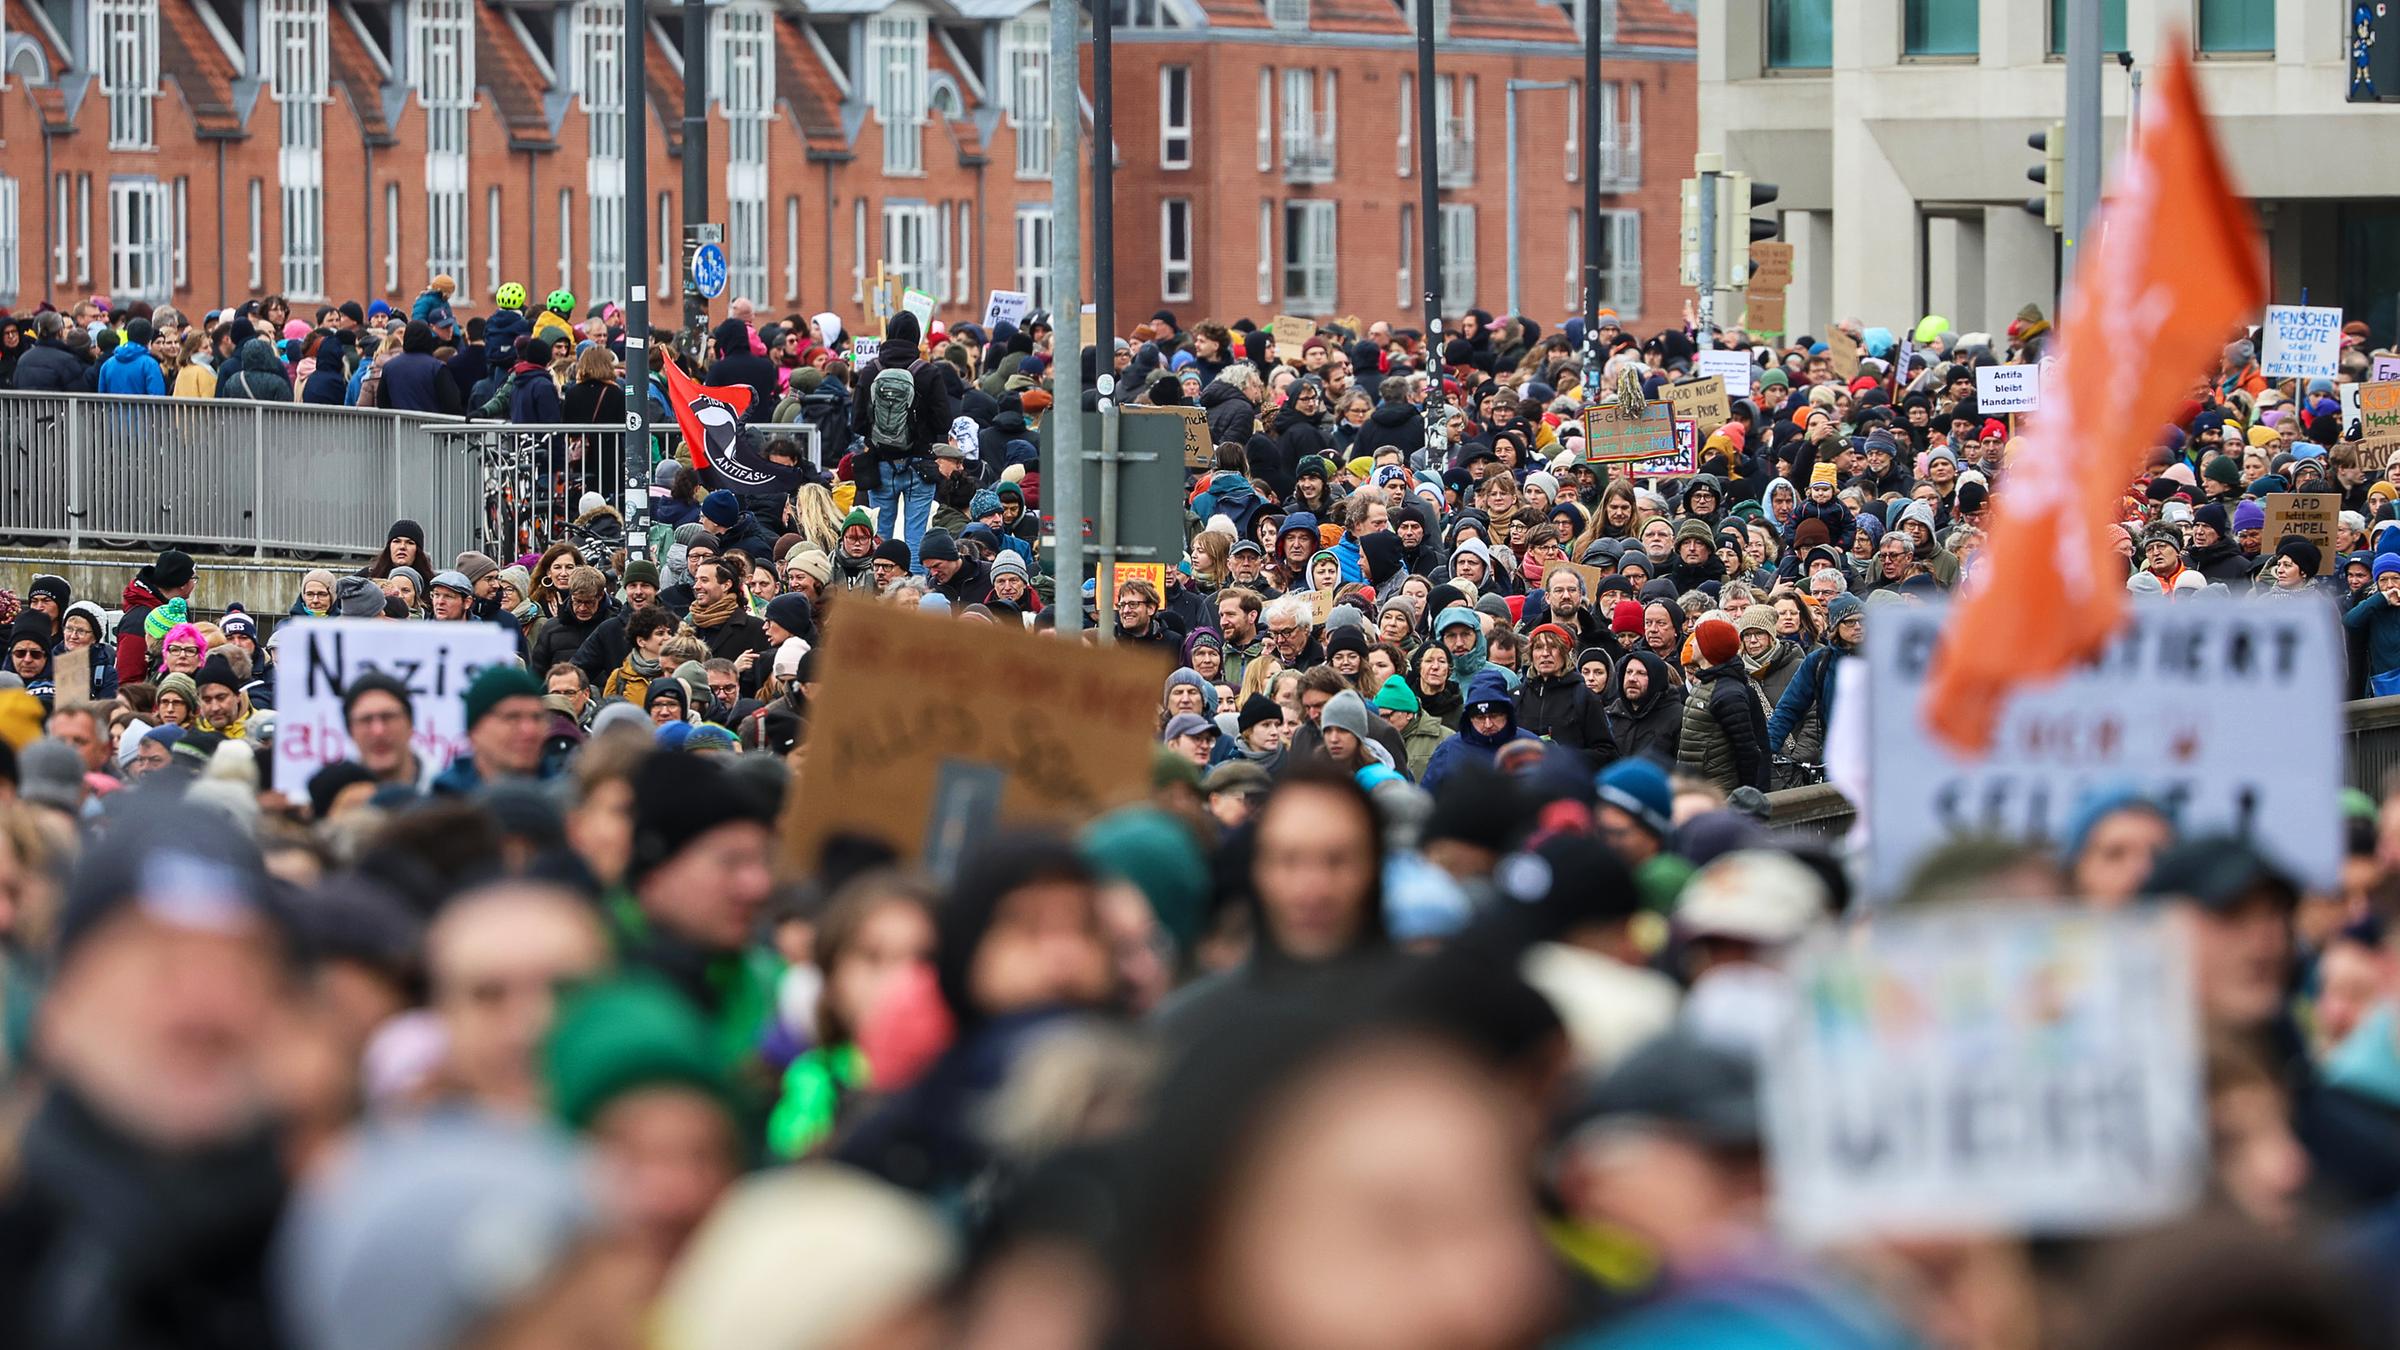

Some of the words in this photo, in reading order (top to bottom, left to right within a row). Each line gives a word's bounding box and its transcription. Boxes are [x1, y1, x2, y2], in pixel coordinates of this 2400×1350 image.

[2271, 312, 2339, 328] MENSCHEN
[2280, 326, 2329, 343] RECHTE
[1994, 371, 2022, 380] Antifa
[1695, 381, 1719, 397] NIGHT
[1995, 384, 2022, 392] bleibt
[1981, 395, 2036, 406] Handarbeit!
[1697, 403, 1721, 419] PRIDE
[2292, 498, 2320, 510] AFD
[2281, 522, 2328, 534] AMPEL
[1113, 565, 1157, 583] EGEN
